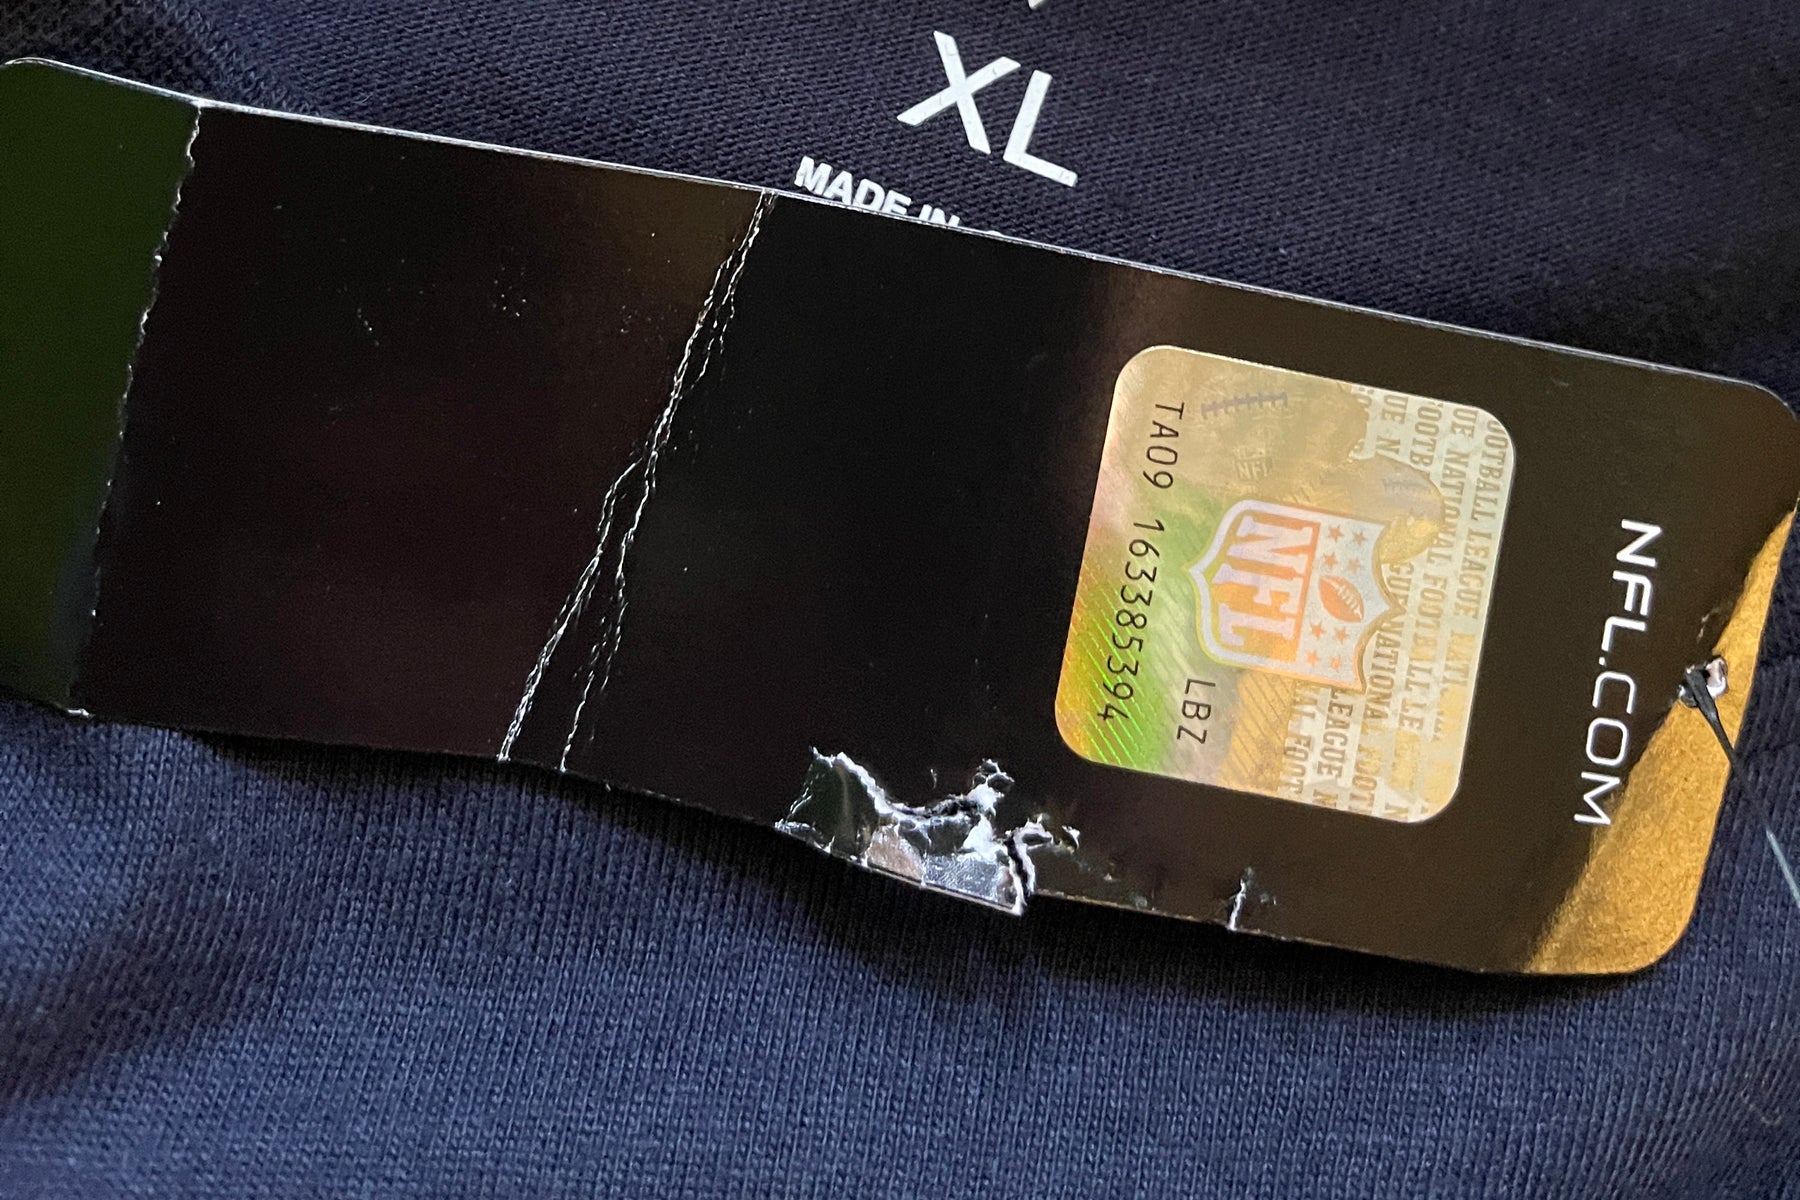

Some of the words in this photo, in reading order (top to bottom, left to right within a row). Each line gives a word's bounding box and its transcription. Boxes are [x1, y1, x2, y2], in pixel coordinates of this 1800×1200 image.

[897, 30, 1078, 187] XL
[794, 155, 912, 216] MADE
[1097, 519, 1166, 722] 163385394
[1212, 516, 1315, 647] NFL
[1176, 678, 1216, 744] LBZ
[1573, 518, 1663, 826] NFL.COM
